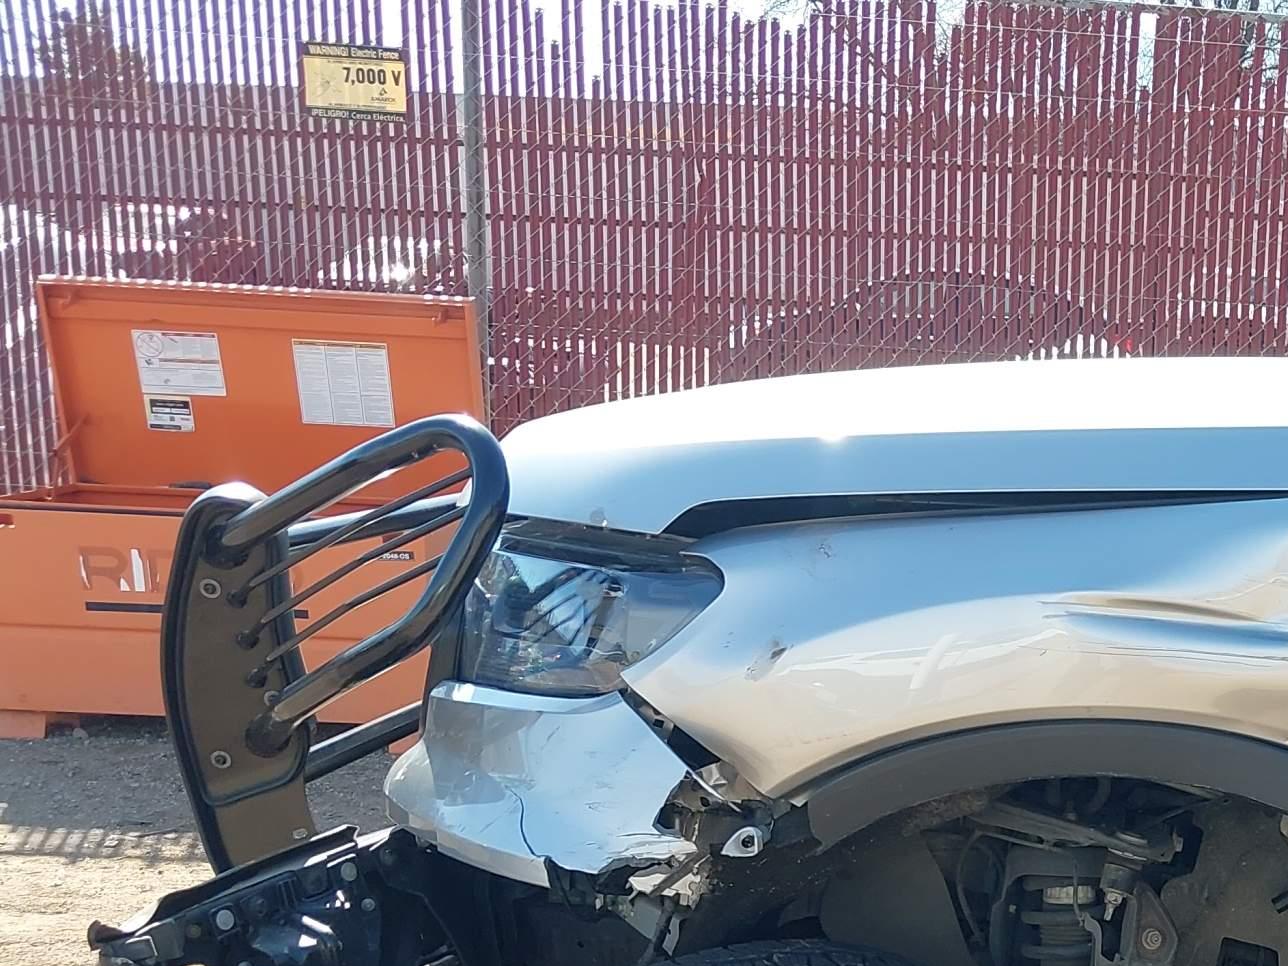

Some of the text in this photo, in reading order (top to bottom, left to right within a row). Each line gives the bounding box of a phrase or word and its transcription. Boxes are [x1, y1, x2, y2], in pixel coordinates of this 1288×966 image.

[308, 45, 400, 60] WARNING! Electric Fence
[342, 67, 402, 86] 7,000 V
[351, 112, 371, 120] Cerca
